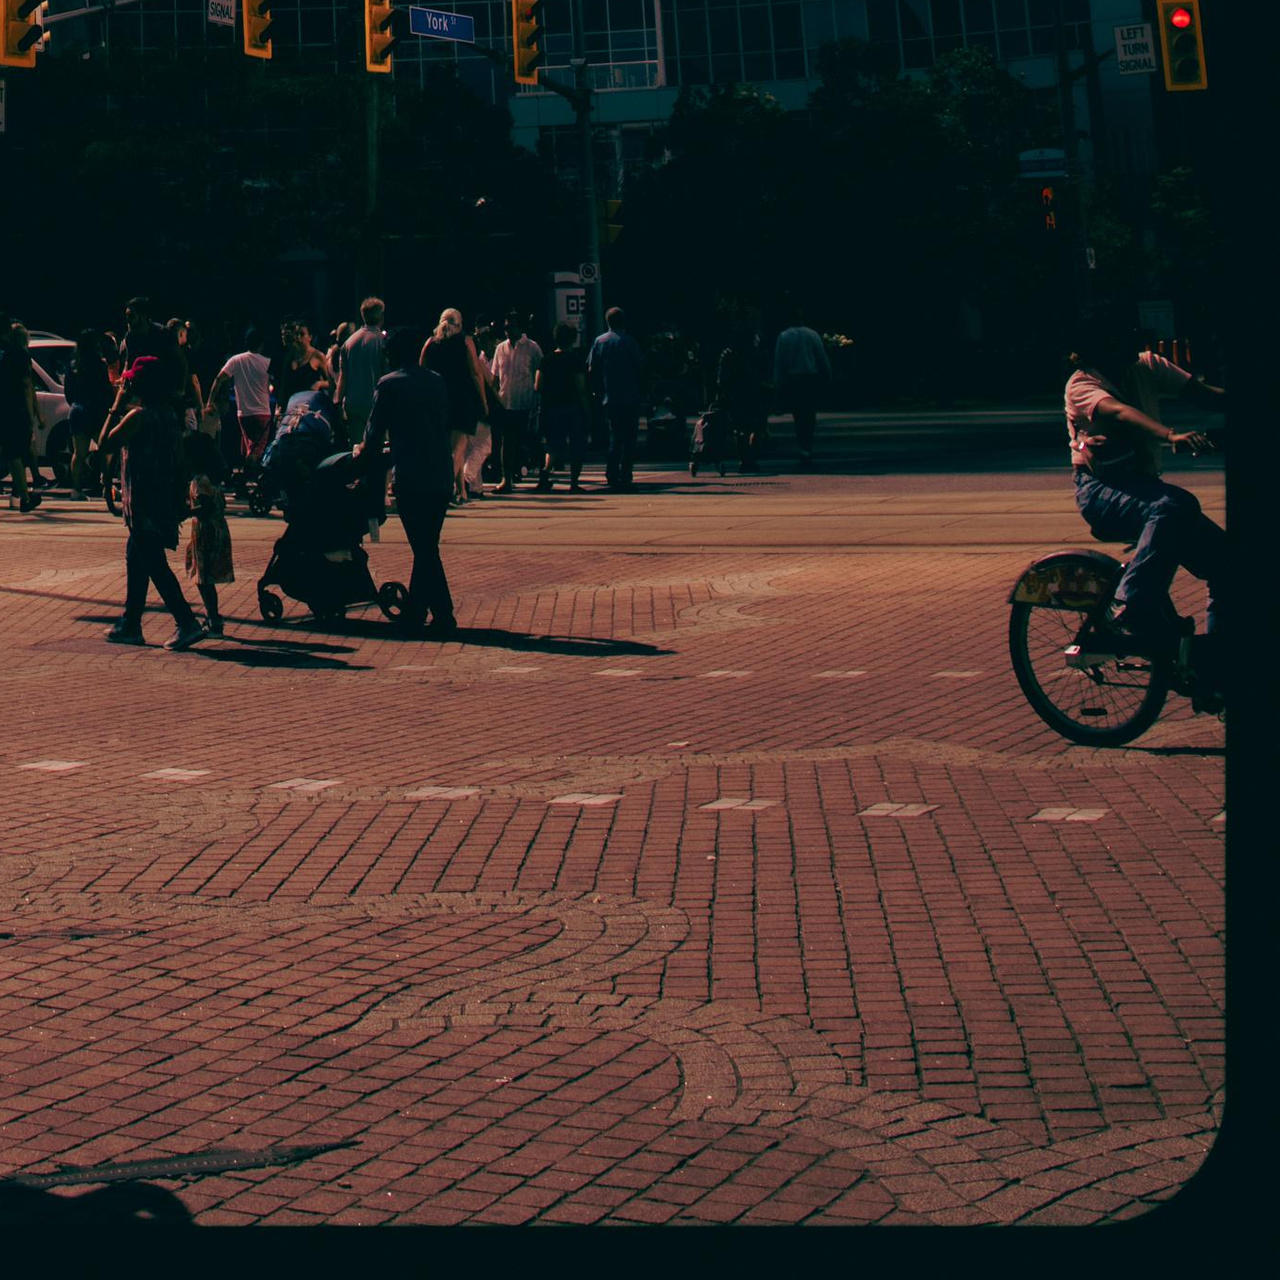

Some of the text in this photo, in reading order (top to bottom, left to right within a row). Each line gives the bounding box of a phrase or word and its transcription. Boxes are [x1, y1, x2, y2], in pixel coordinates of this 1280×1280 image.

[210, 1, 233, 19] SIGNAL
[426, 12, 448, 31] York
[1120, 26, 1144, 40] LEFT
[1122, 42, 1149, 56] TURN
[1120, 57, 1155, 72] SIGNAL
